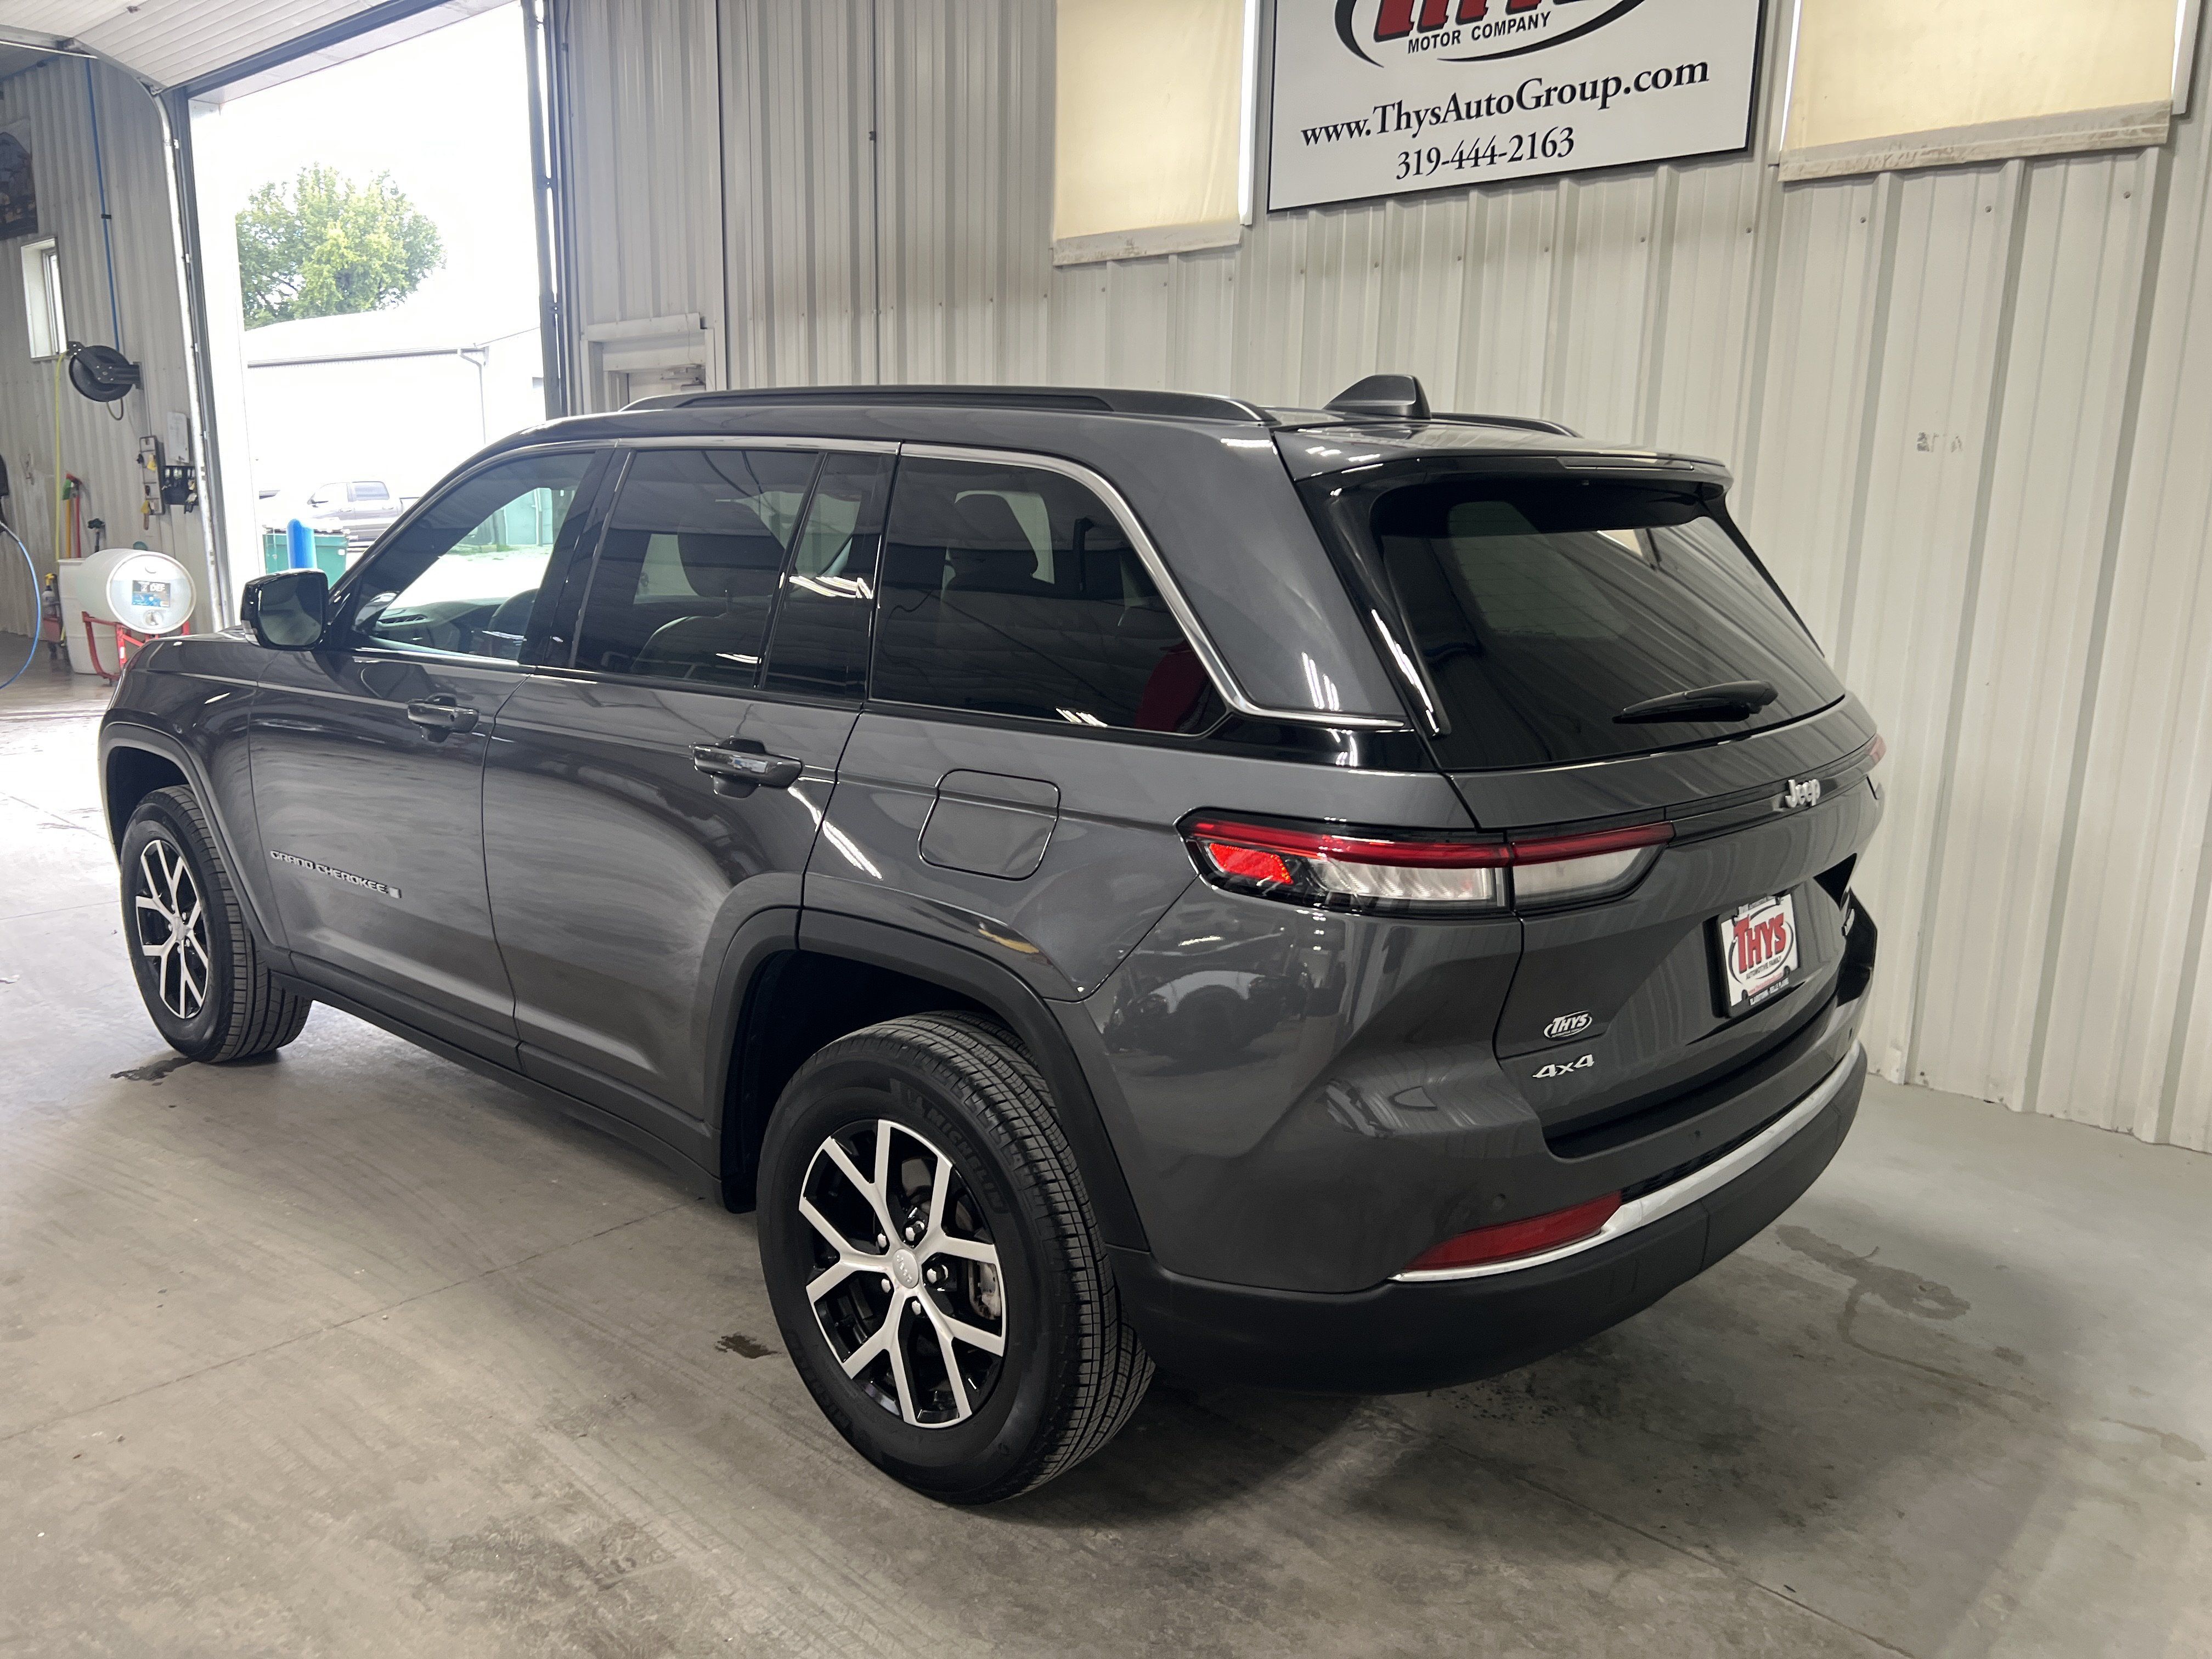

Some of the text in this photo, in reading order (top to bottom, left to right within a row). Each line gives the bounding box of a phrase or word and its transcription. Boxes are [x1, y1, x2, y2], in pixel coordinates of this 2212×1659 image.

[1408, 30, 1461, 54] MOTOR
[1471, 11, 1551, 41] COMPANY
[1301, 60, 1710, 146] www.ThysAutoGroup.com
[1395, 126, 1575, 180] 319-444-2163
[1785, 779, 1820, 808] Jeep
[270, 850, 388, 894] GRAND CHEROKEE
[1734, 913, 1786, 974] THYS
[1550, 1013, 1589, 1034] THYS
[1532, 1053, 1595, 1079] 4x4
[926, 1107, 1004, 1208] MICHELIN
